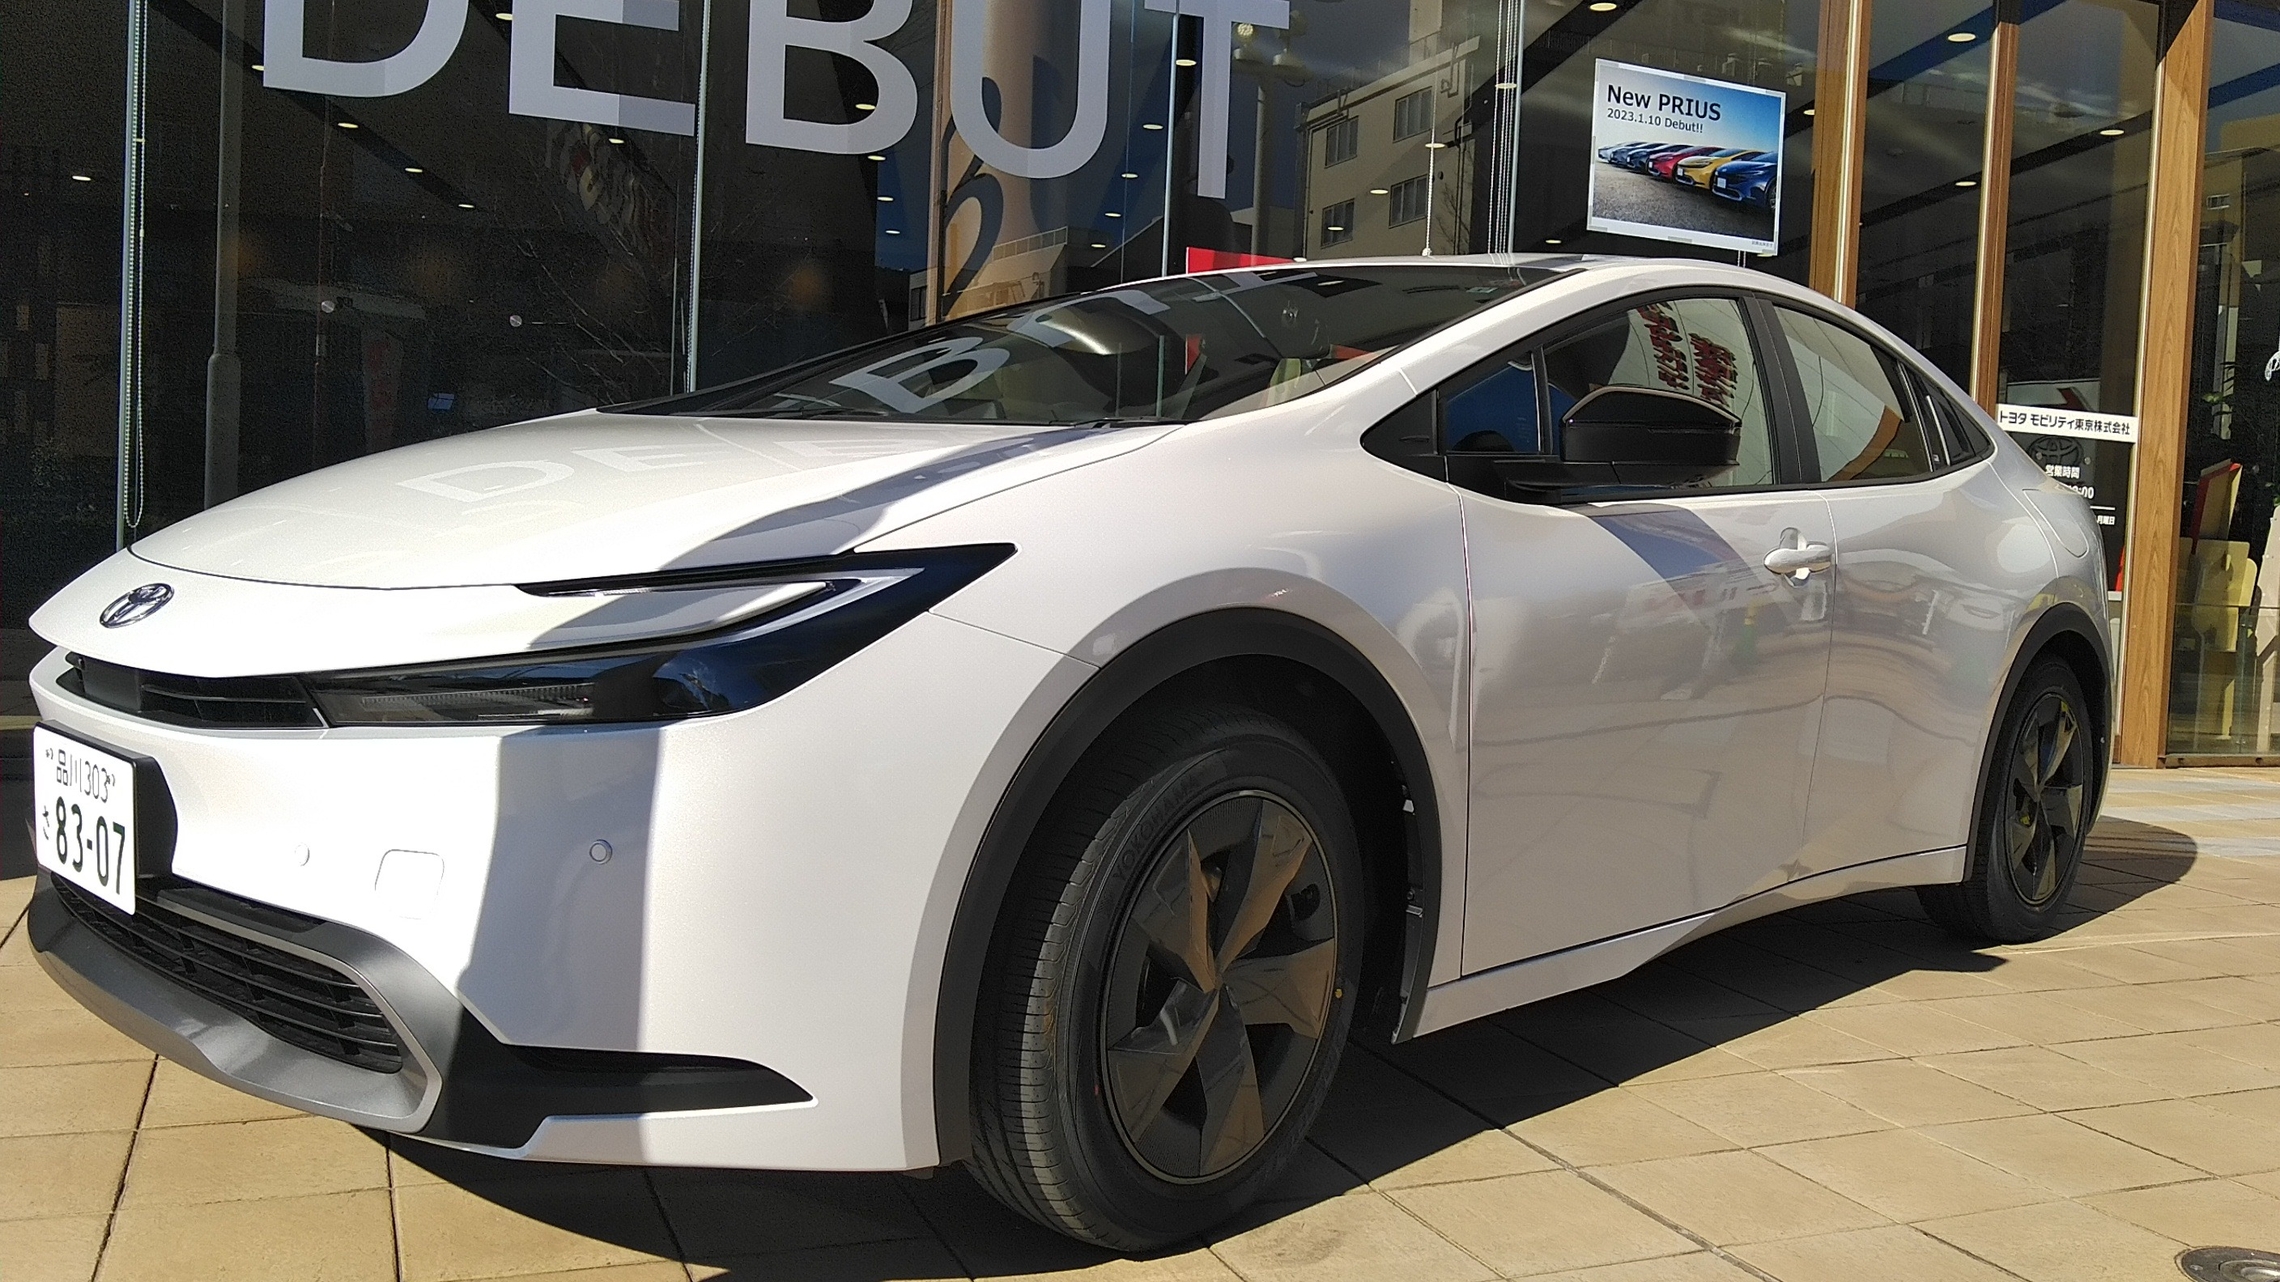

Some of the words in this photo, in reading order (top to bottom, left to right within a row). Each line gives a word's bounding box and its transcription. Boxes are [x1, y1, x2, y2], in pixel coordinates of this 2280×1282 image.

[1607, 84, 1651, 109] New
[1659, 93, 1721, 121] PRIUS
[1607, 107, 1661, 127] 2023.1.10
[1664, 116, 1704, 134] Debut!!
[2045, 464, 2081, 479] 営業時間
[42, 804, 50, 841] さ
[55, 796, 126, 895] 83-07
